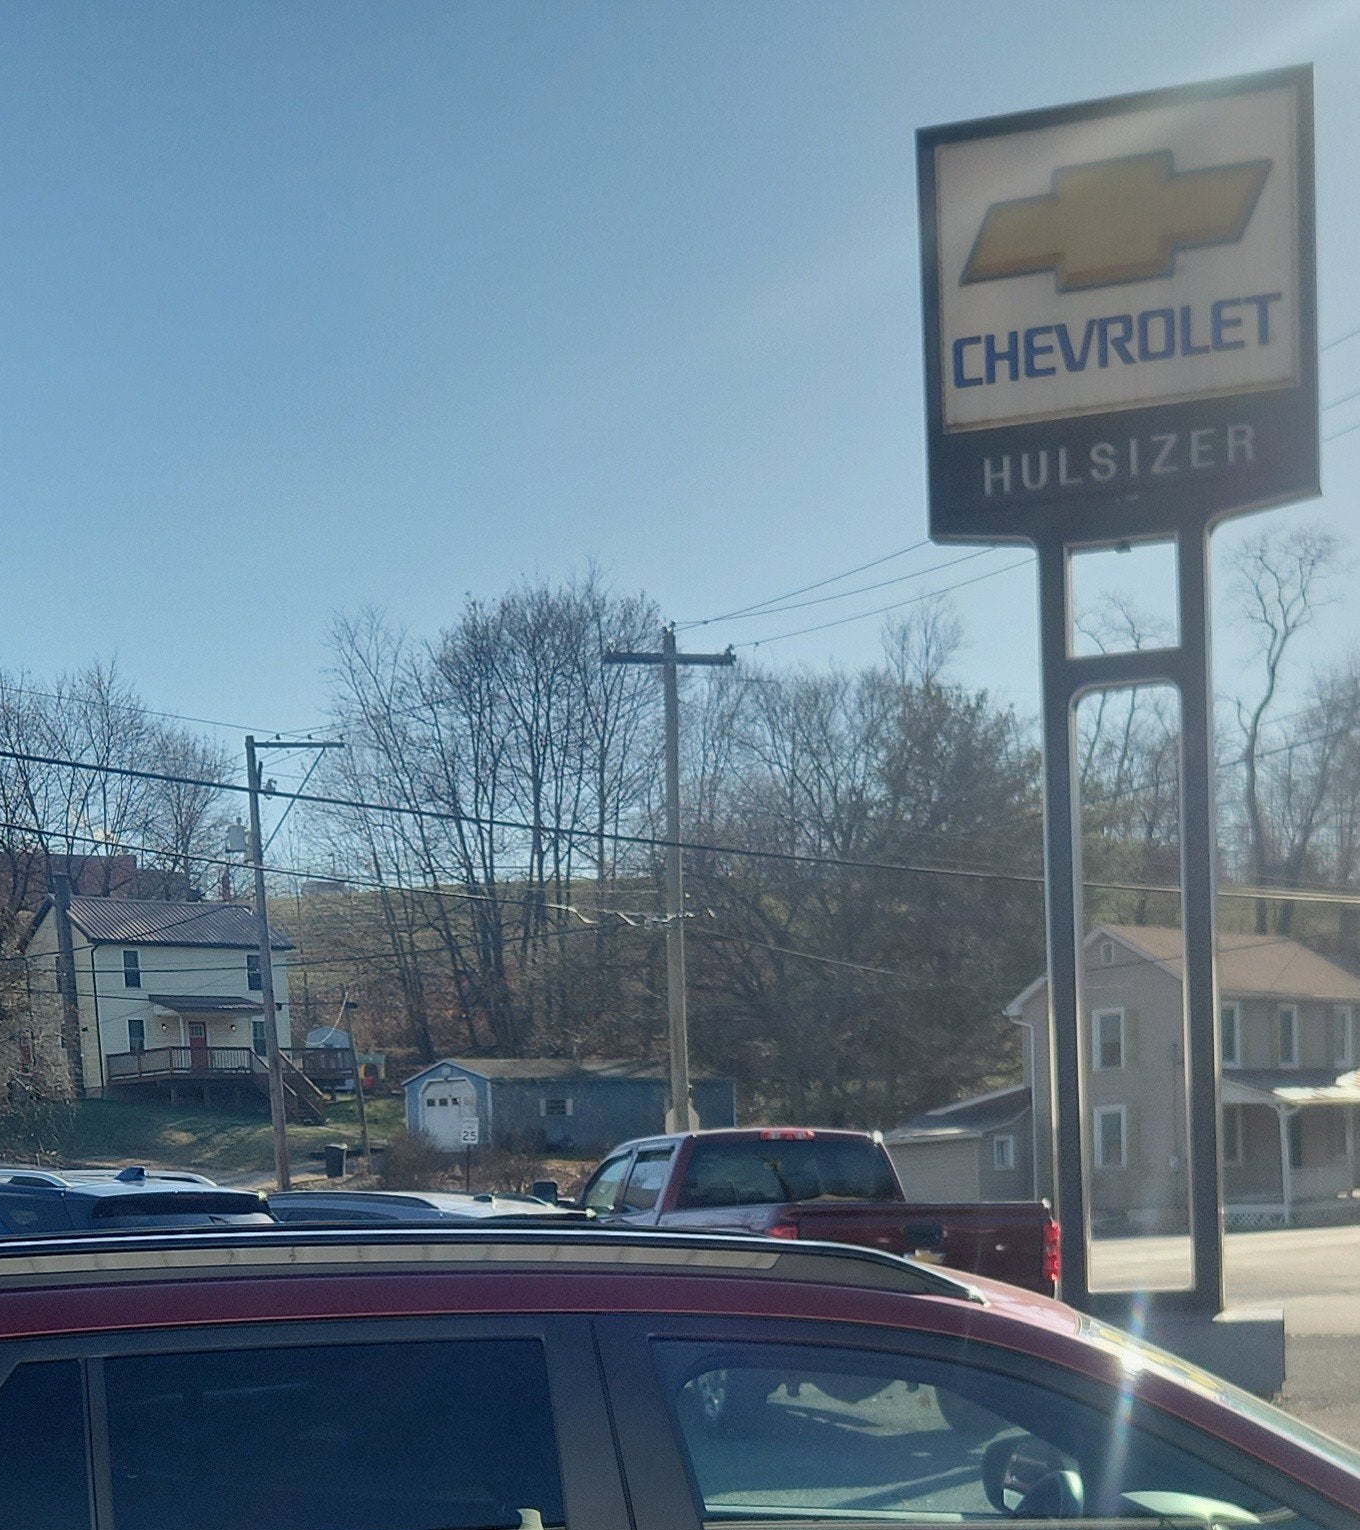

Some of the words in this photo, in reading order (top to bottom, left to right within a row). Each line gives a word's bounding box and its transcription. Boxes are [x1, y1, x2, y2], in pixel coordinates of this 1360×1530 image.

[952, 292, 1282, 389] CHEVROLET
[983, 423, 1257, 496] HULSIZER
[462, 1130, 477, 1141] 25
